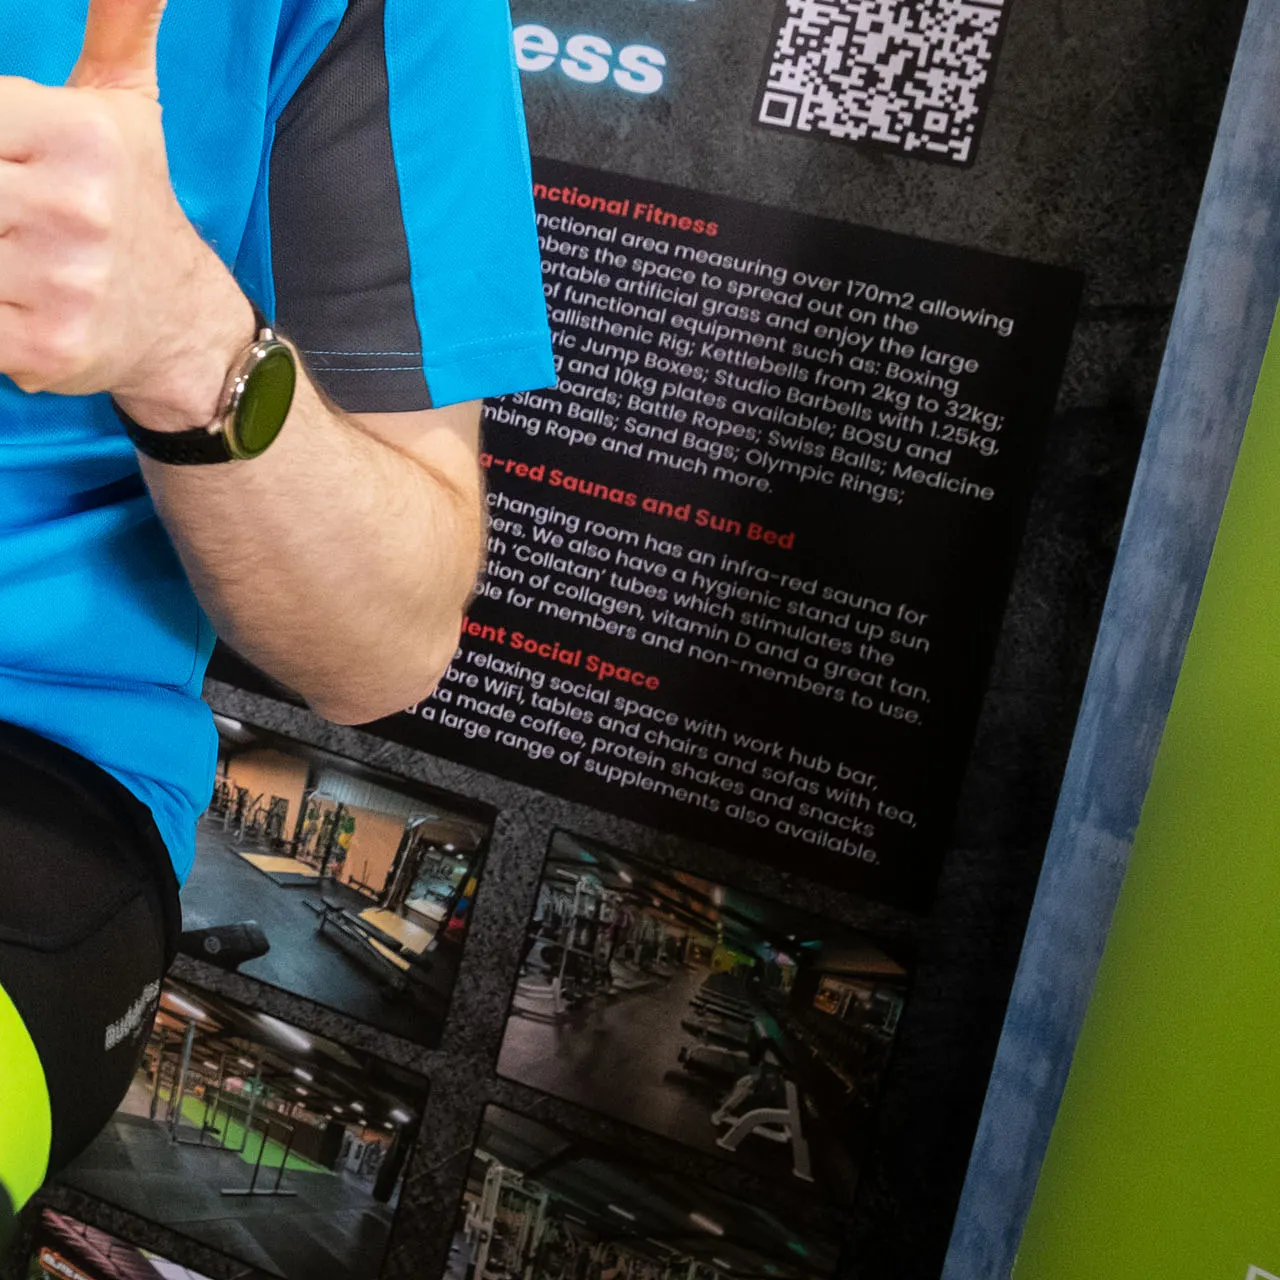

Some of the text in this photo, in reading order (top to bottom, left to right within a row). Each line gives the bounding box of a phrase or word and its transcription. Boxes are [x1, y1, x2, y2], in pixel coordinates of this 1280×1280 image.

[631, 201, 719, 237] Fitness
[593, 246, 920, 336] the space to spread out on the
[614, 276, 980, 376] artificial grass and enjoy the large
[619, 232, 1015, 338] area measuring over 170m2 allowing
[563, 284, 960, 399] functional equipment such as: Boxing
[657, 330, 1005, 433] Rig; Kettlebells from 2kg to 32kg;
[567, 358, 610, 380] and
[613, 365, 658, 397] 10kg
[659, 381, 727, 410] plates
[730, 399, 837, 439] available;
[840, 422, 902, 453] BOSU
[904, 442, 952, 466] and
[579, 336, 640, 367] Jump
[643, 350, 709, 384] Boxes;
[713, 368, 781, 399] Studio
[785, 385, 873, 422] Barbells
[877, 410, 924, 435] with
[929, 419, 1000, 457] 1.25kg,
[626, 393, 995, 501] Battle Ropes; Swiss Balls; Medicine
[543, 418, 773, 493] Rope and much more.
[566, 400, 620, 431] Balls;
[623, 415, 679, 444] Sand
[681, 430, 740, 463] Bags;
[744, 447, 835, 485] Olympic
[838, 471, 905, 505] Rings;
[485, 491, 929, 626] changing room has an infra-red sauna for
[547, 467, 796, 550] Saunas and Sun Bed
[527, 573, 930, 703] of collagen, vitamin D and a great tan.
[531, 524, 564, 548] We
[567, 538, 611, 562] also
[614, 547, 668, 578] have
[670, 567, 687, 583] a
[690, 569, 782, 610] hygienic
[785, 600, 851, 629] stand
[854, 619, 884, 642] up
[888, 629, 930, 653] sun
[609, 571, 895, 667] tubes which stimulates the
[505, 586, 535, 609] for
[536, 599, 637, 640] members
[640, 630, 685, 654] and
[687, 643, 845, 702] non-members
[850, 689, 874, 710] to
[877, 700, 922, 726] use.
[508, 630, 660, 691] Social Space
[455, 693, 516, 723] made
[519, 714, 587, 749] coffee,
[589, 736, 666, 771] protein
[670, 761, 744, 796] shakes
[749, 786, 794, 811] and
[797, 801, 875, 838] snacks
[465, 650, 546, 690] relaxing
[548, 675, 611, 706] social
[613, 695, 680, 726] space
[683, 717, 728, 742] with
[732, 732, 784, 759] work
[787, 745, 832, 774] hub
[835, 761, 878, 791] bar,
[483, 674, 525, 706] WiFi,
[530, 690, 594, 724] tables
[597, 714, 641, 739] and
[643, 729, 708, 760] chairs
[713, 751, 757, 775] and
[761, 766, 820, 795] sofas
[825, 786, 871, 811] with
[875, 799, 917, 829] tea,
[438, 707, 492, 739] large
[493, 728, 556, 760] range
[558, 750, 582, 767] of
[582, 757, 720, 812] supplements
[724, 803, 770, 828] also
[774, 819, 880, 865] available.
